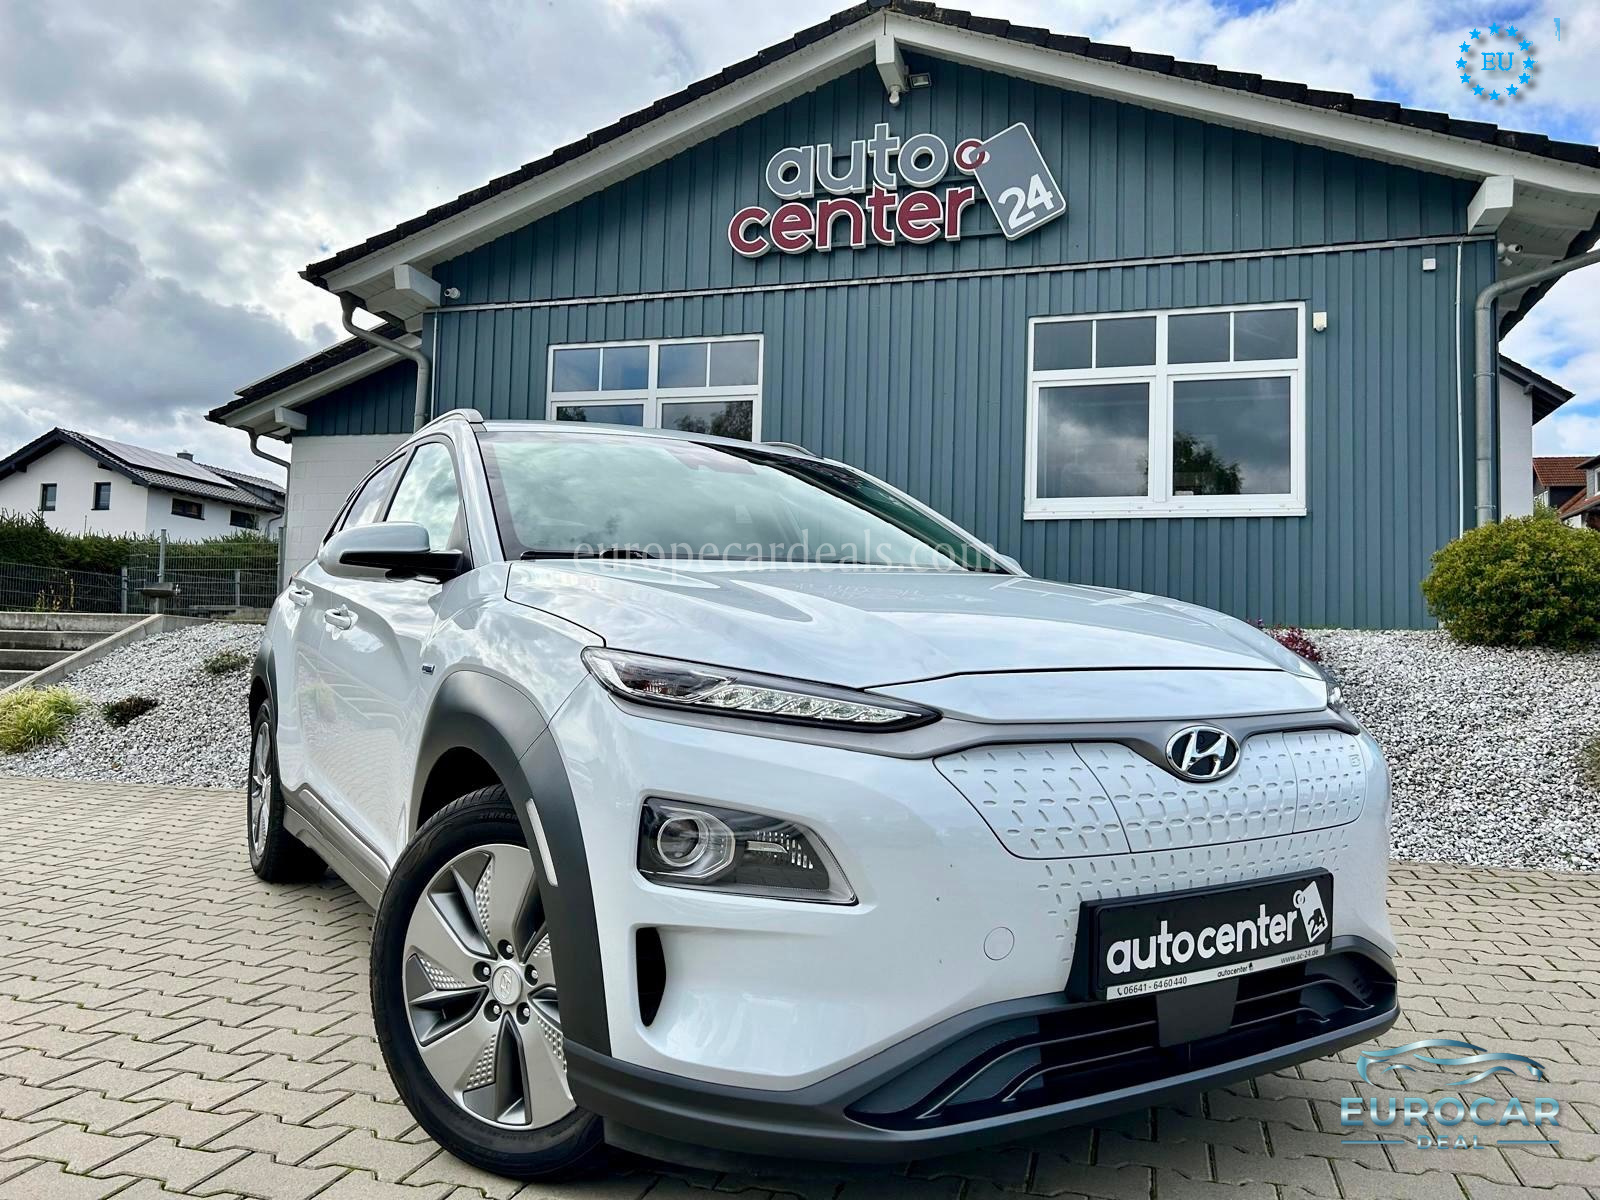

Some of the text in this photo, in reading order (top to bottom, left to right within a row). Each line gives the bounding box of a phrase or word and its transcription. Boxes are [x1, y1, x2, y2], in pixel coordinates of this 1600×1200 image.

[765, 122, 949, 200] auto
[727, 182, 975, 258] center
[998, 173, 1053, 230] 24
[1307, 907, 1326, 938] 24
